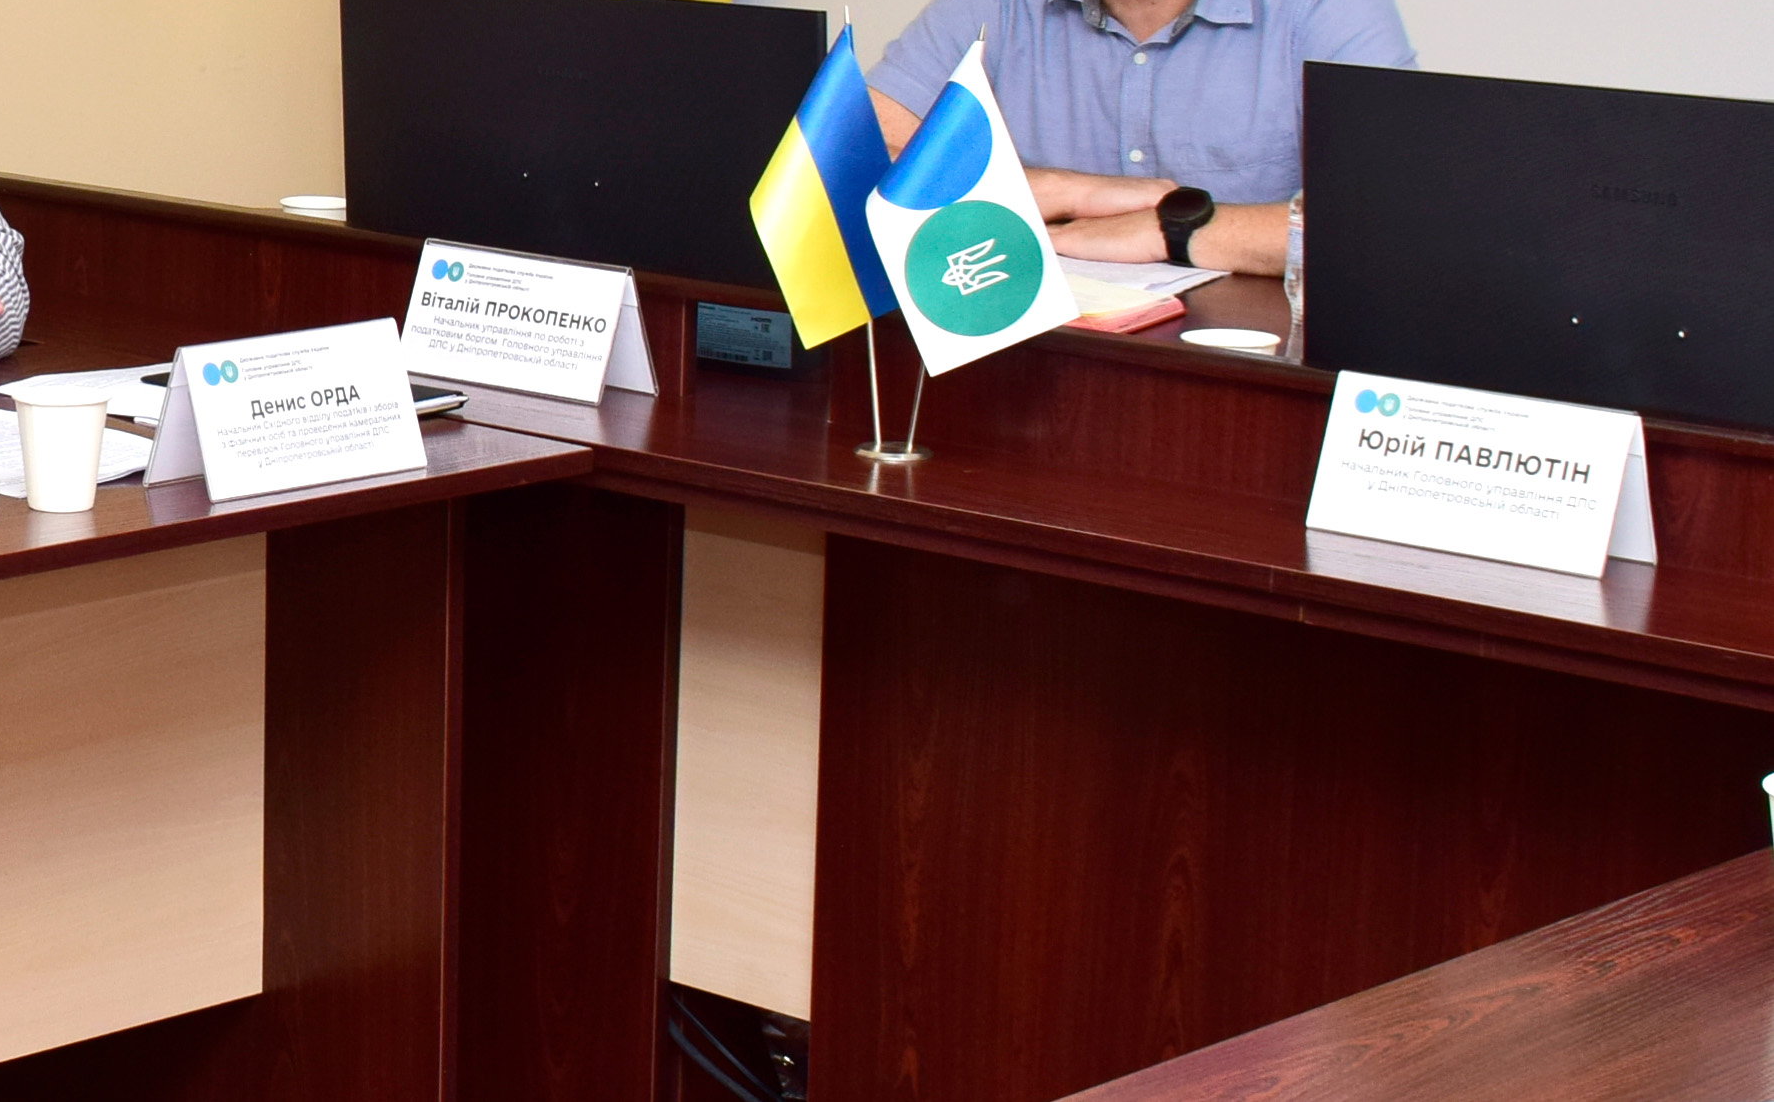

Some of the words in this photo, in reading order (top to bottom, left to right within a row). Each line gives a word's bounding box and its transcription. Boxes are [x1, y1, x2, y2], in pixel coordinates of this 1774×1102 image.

[421, 291, 480, 314] Віталій
[484, 301, 606, 333] ПРОКОПЕНКО
[411, 325, 463, 340] податковим
[465, 333, 497, 345] боргом
[502, 338, 549, 353] Головного
[551, 348, 602, 361] управління
[434, 315, 479, 330] Начальник
[481, 324, 532, 340] управління
[548, 334, 577, 345] роботі
[580, 339, 584, 347] з
[428, 338, 448, 349] ДПС
[449, 343, 455, 352] у
[456, 342, 541, 364] Дніпропетровській
[543, 358, 578, 370] області
[251, 396, 306, 420] Денис
[310, 385, 360, 406] ОРДА
[1358, 429, 1425, 457] Юрій
[1435, 440, 1590, 483] ПАВЛЮТІН
[1341, 460, 1409, 478] Начальник
[1413, 470, 1482, 491] Головного
[1486, 485, 1562, 503] управління
[1566, 495, 1596, 510] ДПС
[1367, 481, 1375, 490] у
[1378, 481, 1505, 509] Дніпропетровській
[1510, 504, 1559, 519] області
